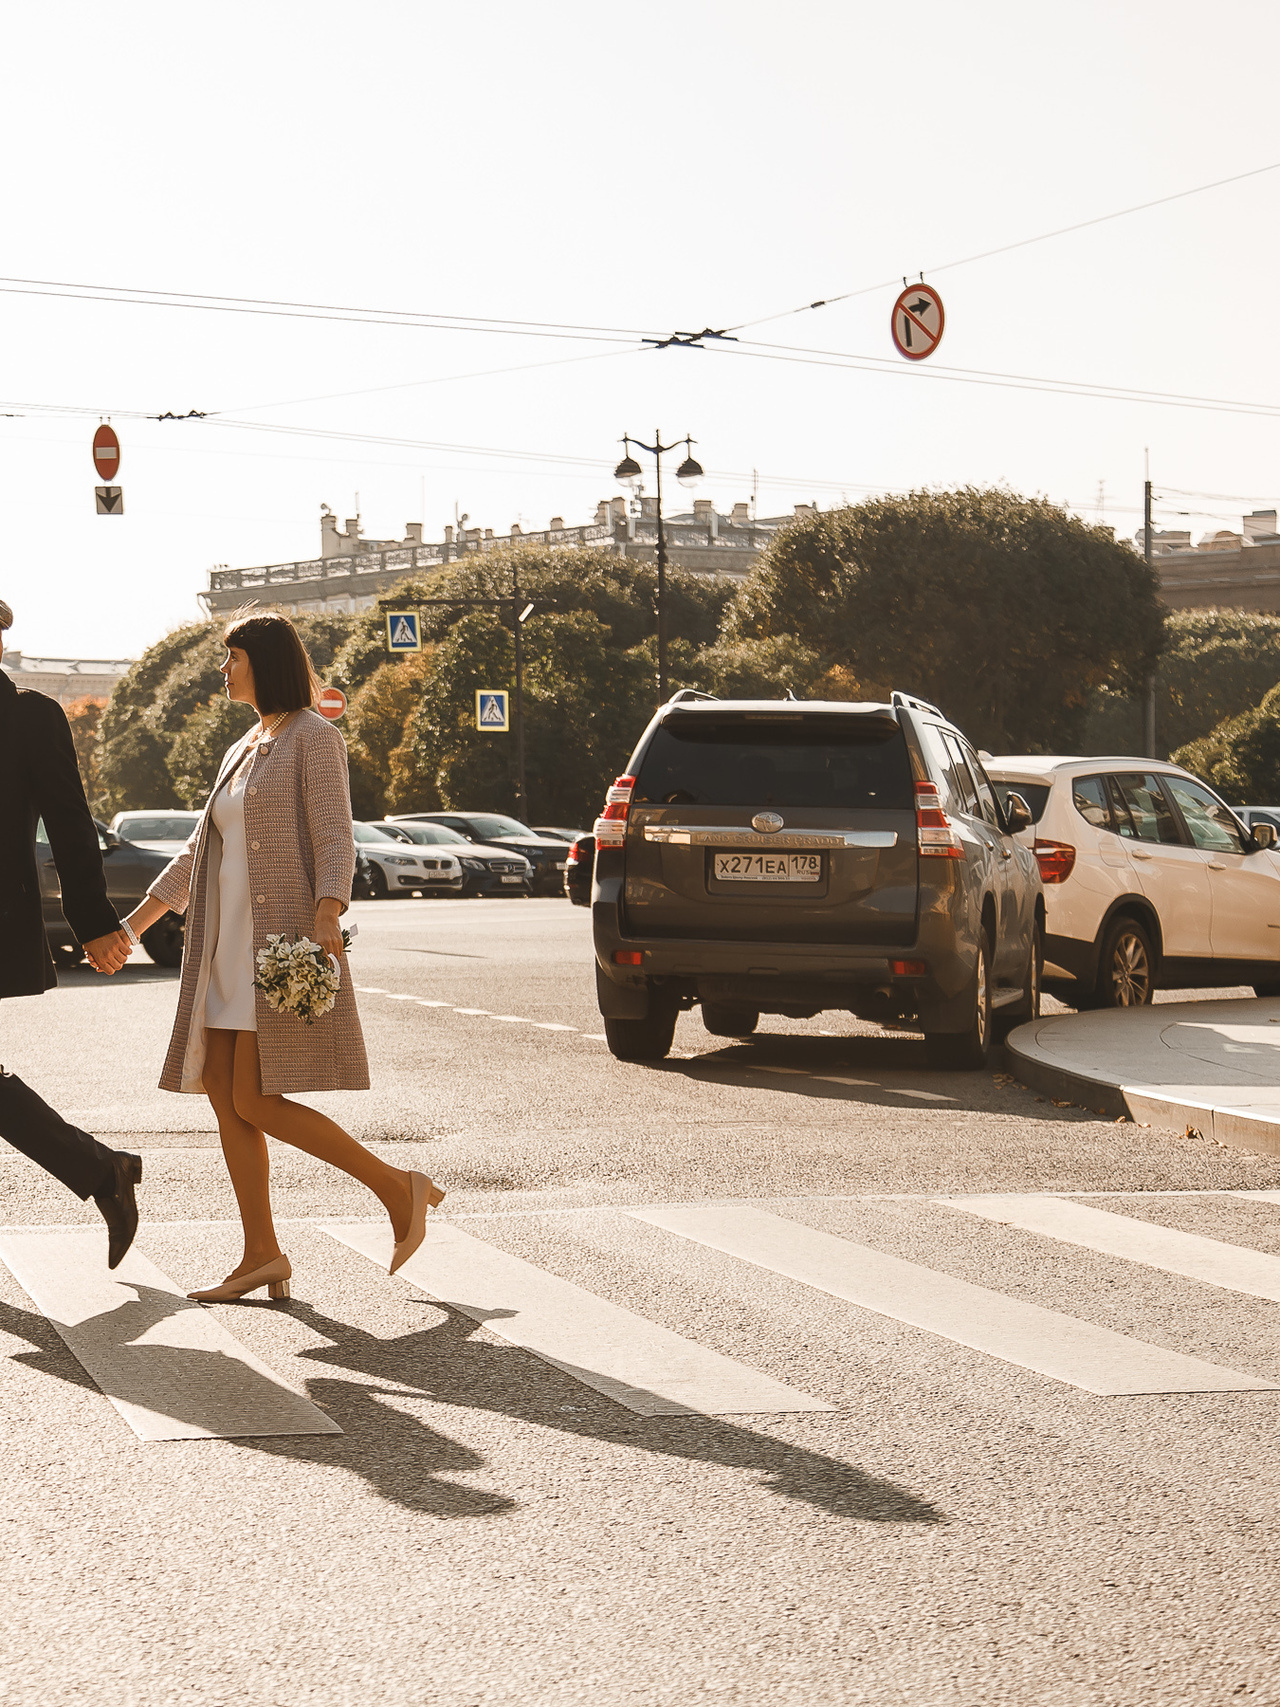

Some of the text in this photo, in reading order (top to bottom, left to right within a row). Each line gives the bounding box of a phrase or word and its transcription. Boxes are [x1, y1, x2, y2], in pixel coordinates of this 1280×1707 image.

[696, 834, 839, 846] LAND CRUISER PRADO
[791, 856, 817, 870] 178
